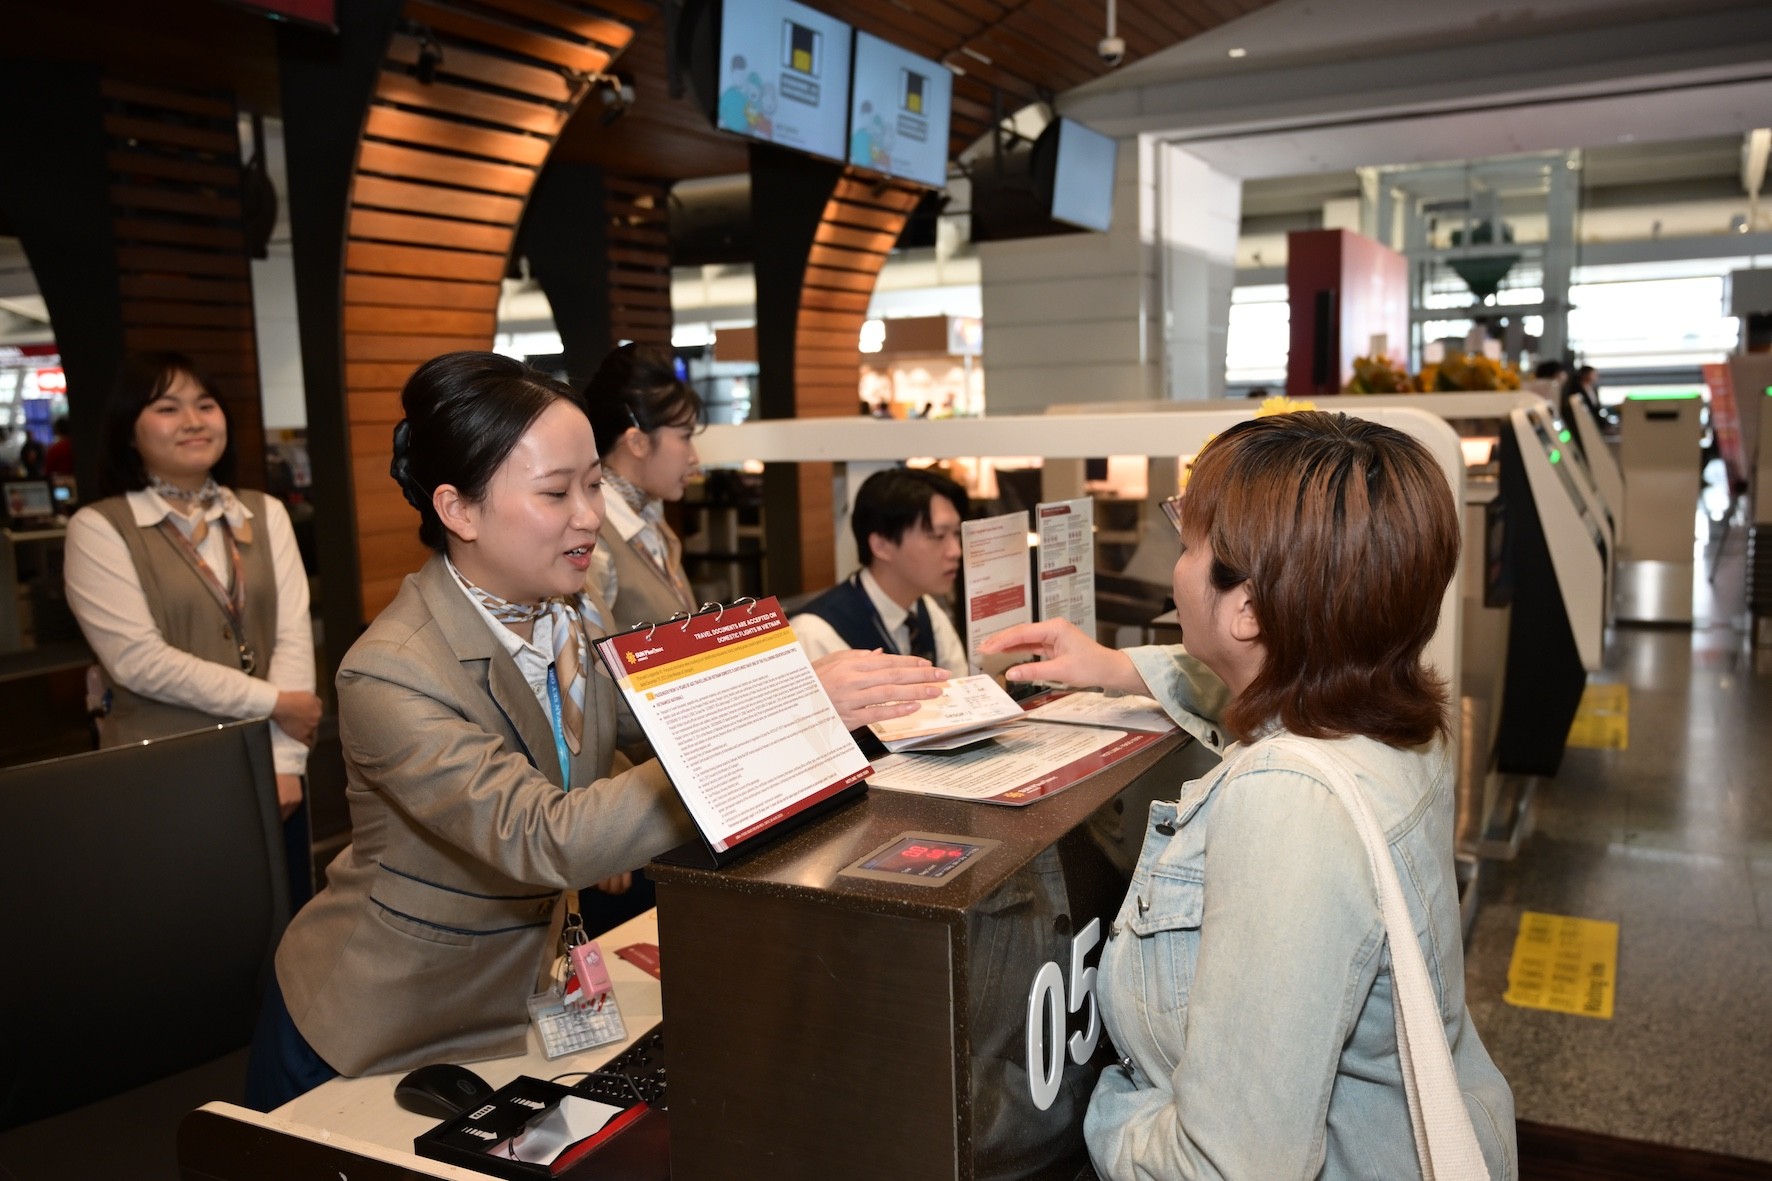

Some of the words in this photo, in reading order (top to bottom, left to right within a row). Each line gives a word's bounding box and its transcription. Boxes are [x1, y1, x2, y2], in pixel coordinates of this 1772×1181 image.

[694, 631, 712, 640] TRAVEL
[712, 624, 738, 635] DOCUMENTS
[747, 615, 770, 625] ACCEPTED
[717, 633, 739, 643] DOMESTIC
[739, 628, 757, 637] FLIGHTS
[761, 620, 781, 630] VIETNAM
[1026, 917, 1100, 1112] 05
